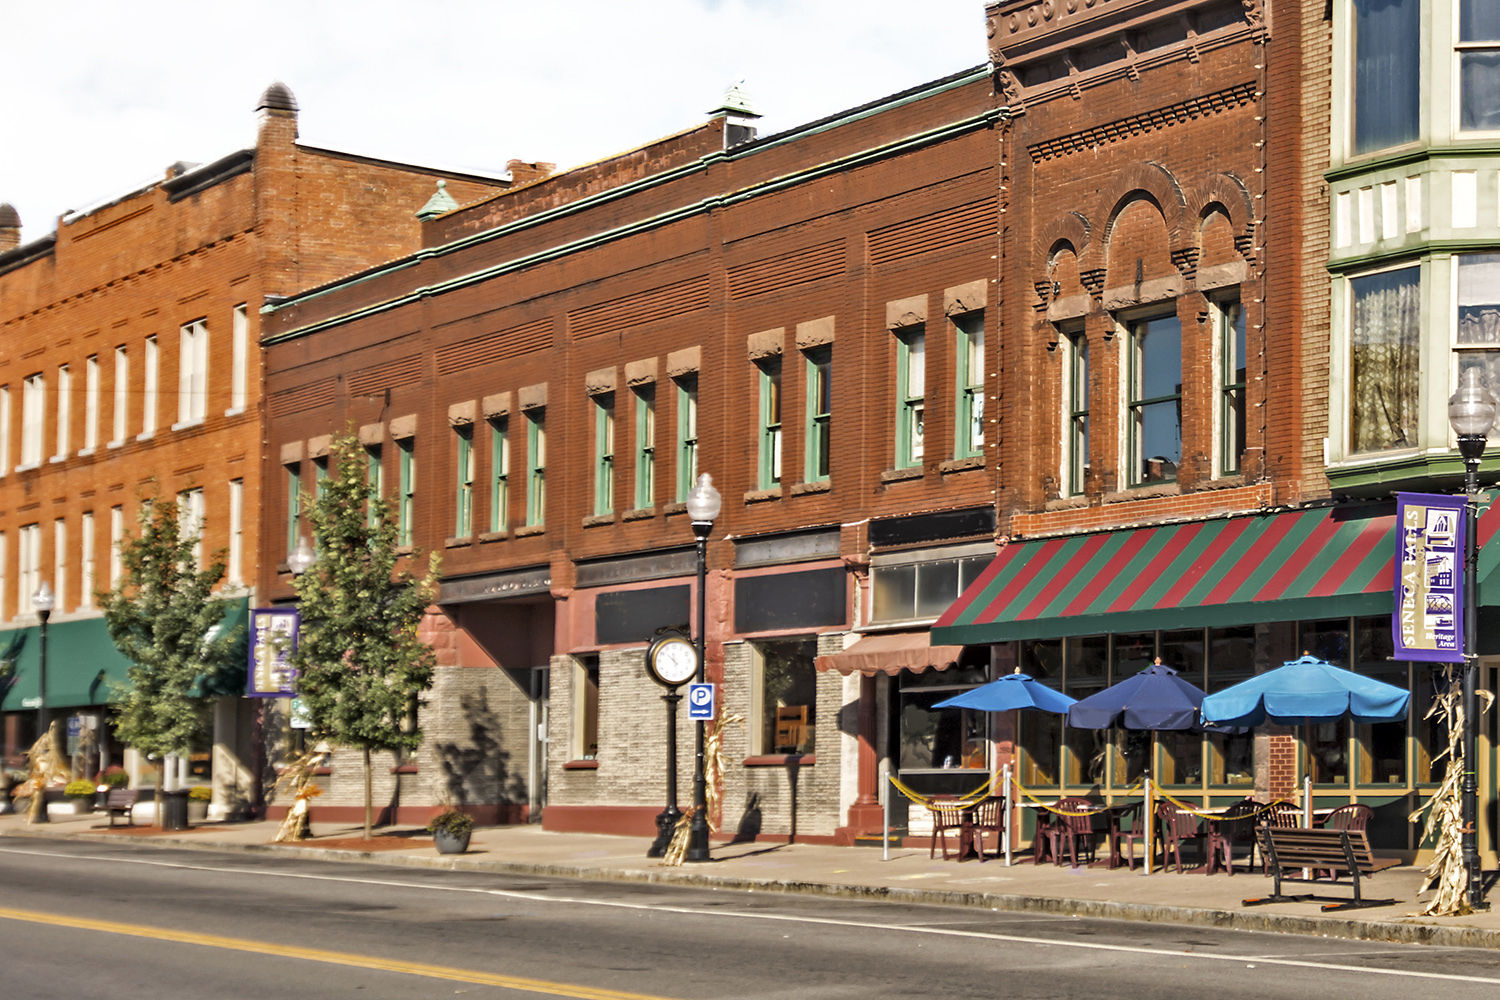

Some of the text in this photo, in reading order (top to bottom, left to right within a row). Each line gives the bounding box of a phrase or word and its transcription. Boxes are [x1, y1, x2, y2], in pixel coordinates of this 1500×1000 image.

[1403, 510, 1419, 646] SENECA FALLS
[1425, 632, 1455, 641] Heritage
[696, 690, 706, 703] P
